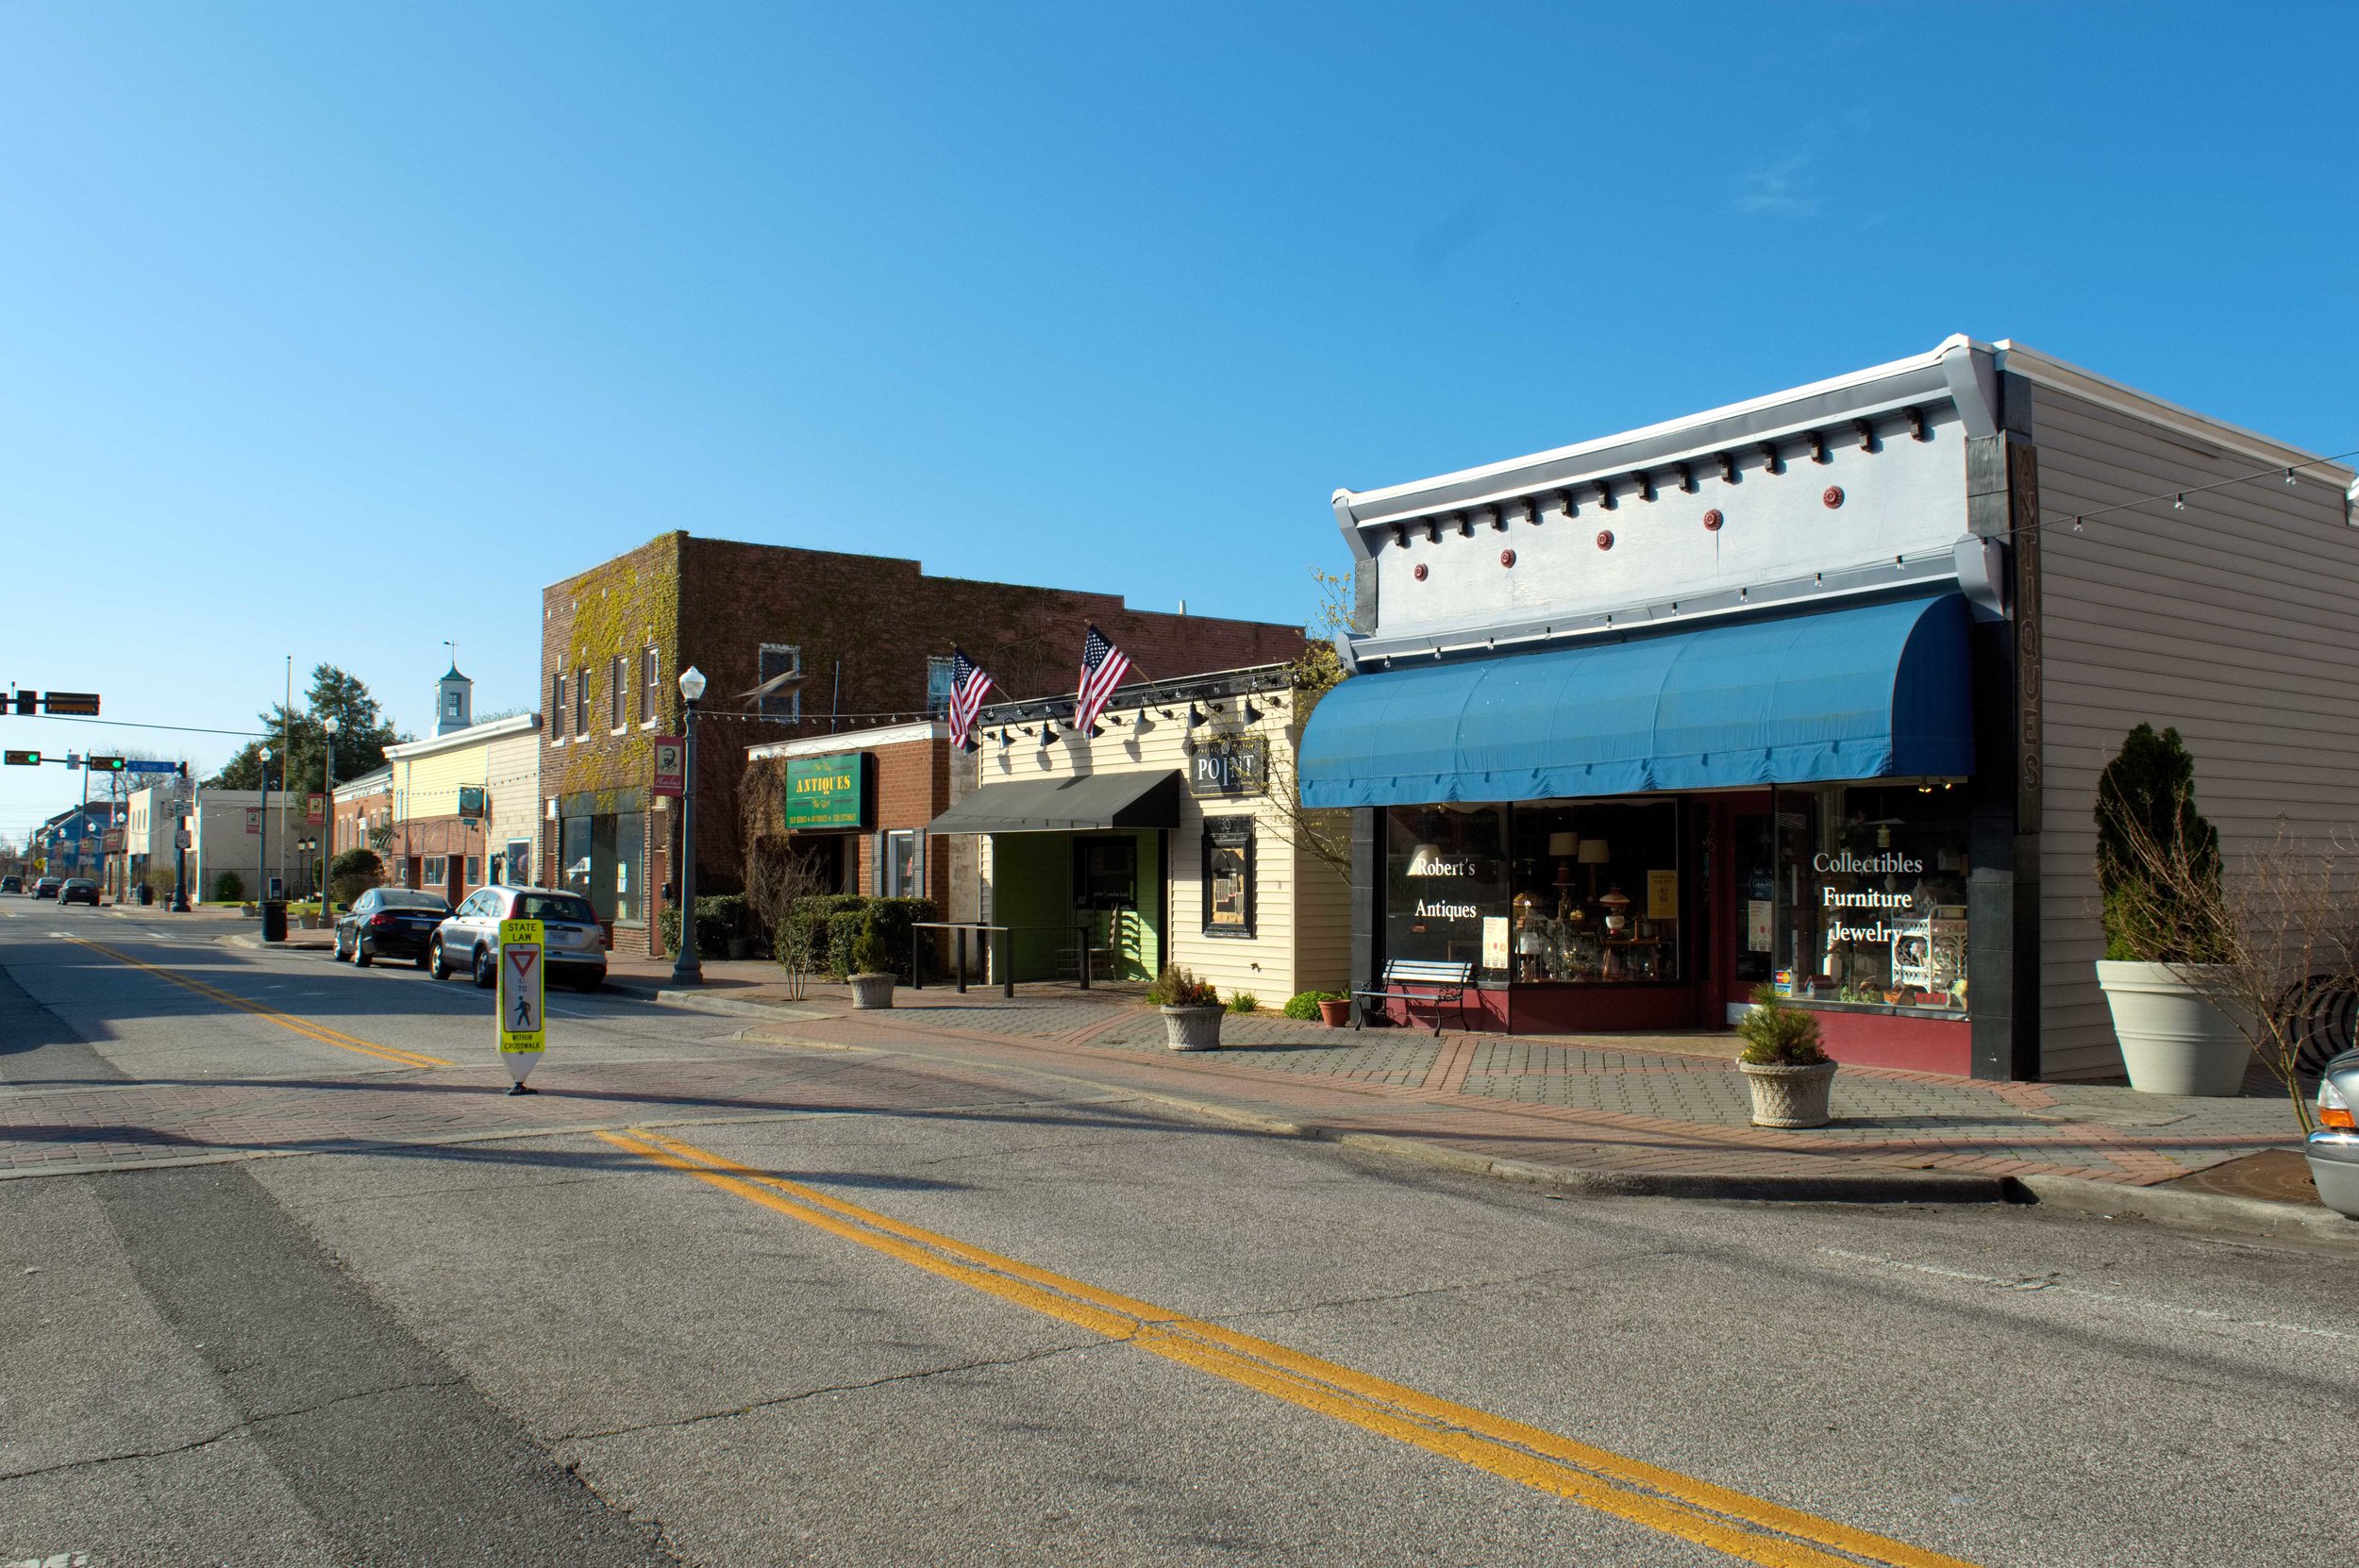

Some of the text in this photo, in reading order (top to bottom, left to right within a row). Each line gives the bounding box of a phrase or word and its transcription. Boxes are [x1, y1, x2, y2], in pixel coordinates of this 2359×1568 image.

[2019, 450, 2041, 792] ANTIQUES
[1197, 755, 1254, 787] POINT
[795, 775, 851, 795] ANTIQUES
[1417, 857, 1476, 876] Robert's
[1813, 852, 1923, 873] Collectibles
[1823, 887, 1912, 908] Furniture
[1414, 898, 1477, 922] Antiques
[509, 923, 537, 931] STATE
[512, 933, 532, 942] LAW
[1832, 921, 1902, 944] Jewelry
[504, 1042, 541, 1050] CROSSWALK
